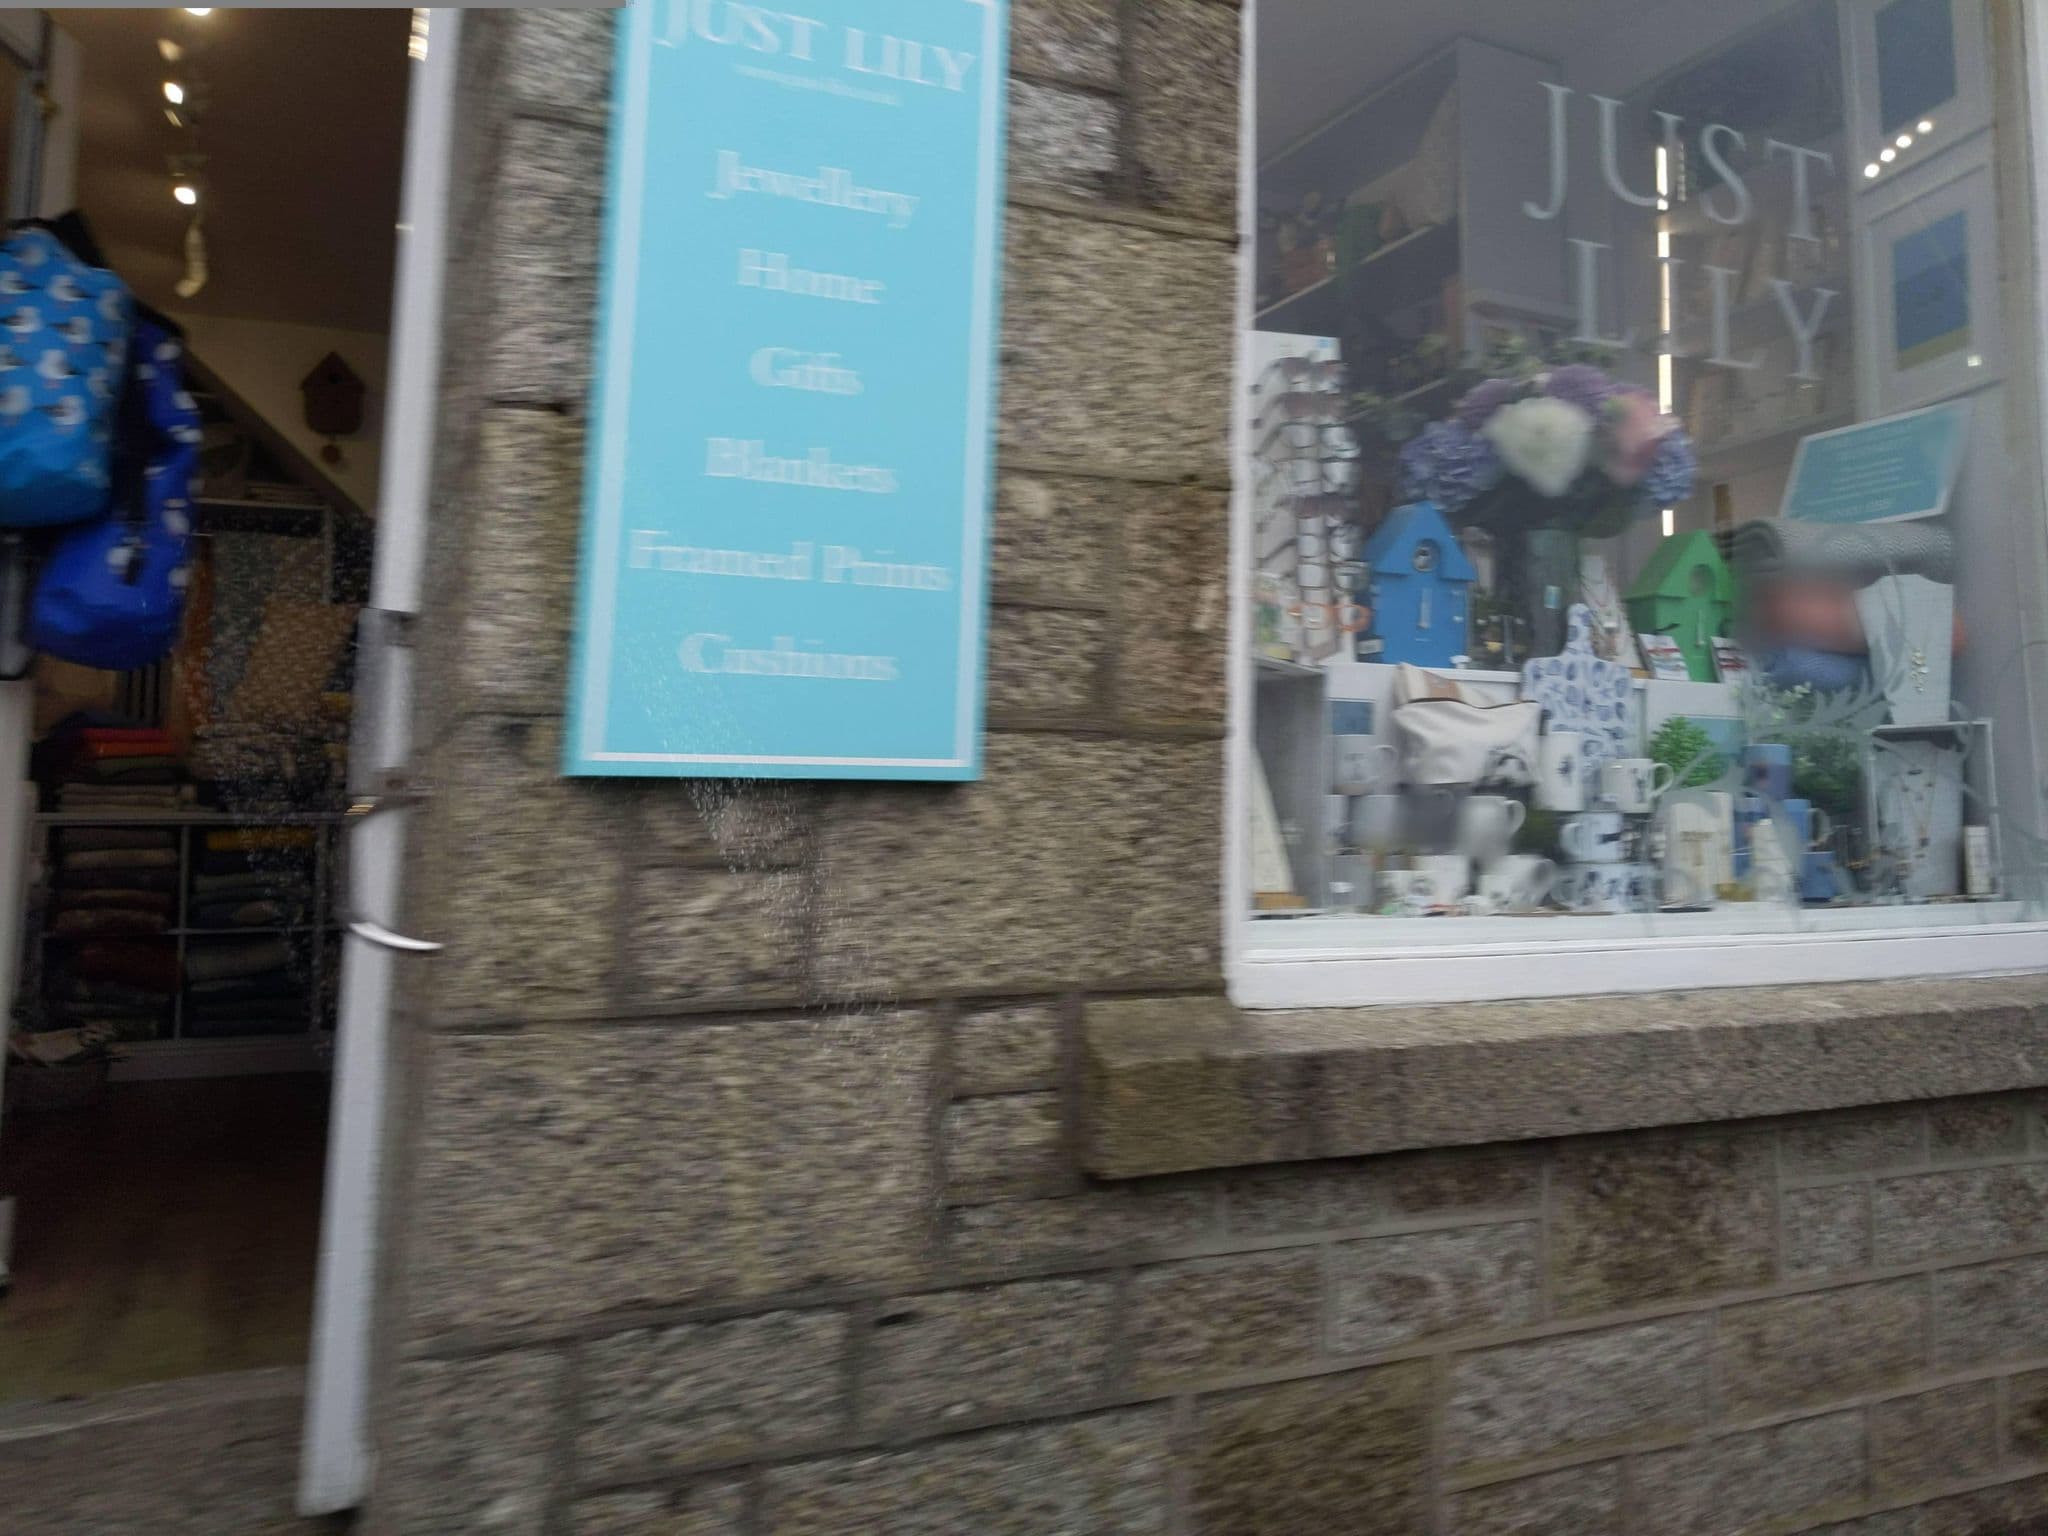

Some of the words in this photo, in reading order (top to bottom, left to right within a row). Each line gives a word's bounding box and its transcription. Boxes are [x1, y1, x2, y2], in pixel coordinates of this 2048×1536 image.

[651, 0, 828, 62] JUST
[842, 26, 976, 92] LILY
[1522, 81, 1836, 241] JUST
[737, 247, 887, 304] Home
[1566, 238, 1840, 381] LILY
[629, 529, 815, 581] Framed
[821, 544, 951, 591] Prints
[679, 633, 898, 681] Cushions
